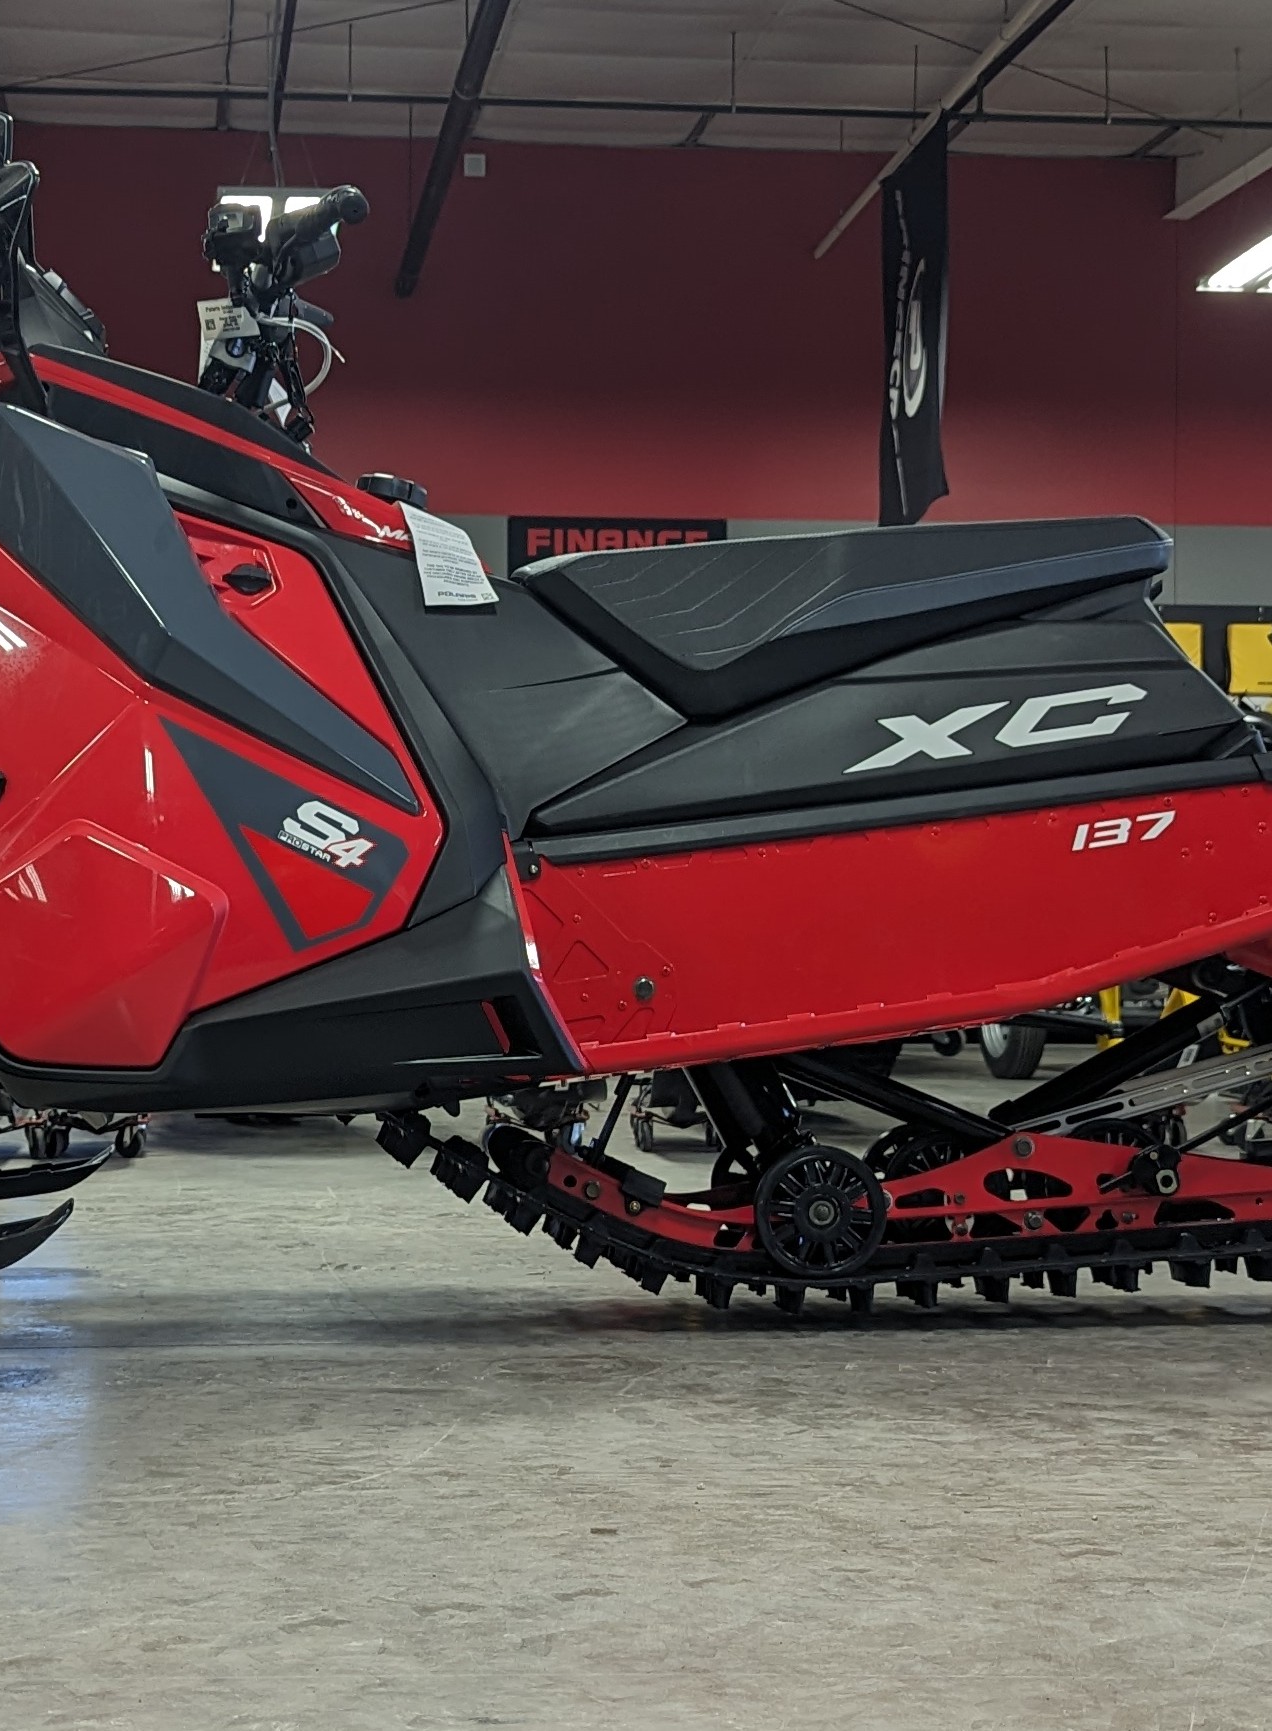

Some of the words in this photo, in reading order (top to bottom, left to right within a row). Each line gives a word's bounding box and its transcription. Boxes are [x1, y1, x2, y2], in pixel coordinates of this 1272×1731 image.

[841, 683, 1148, 775] XC
[277, 829, 331, 863] PROSTAR
[1071, 810, 1176, 852] 137
